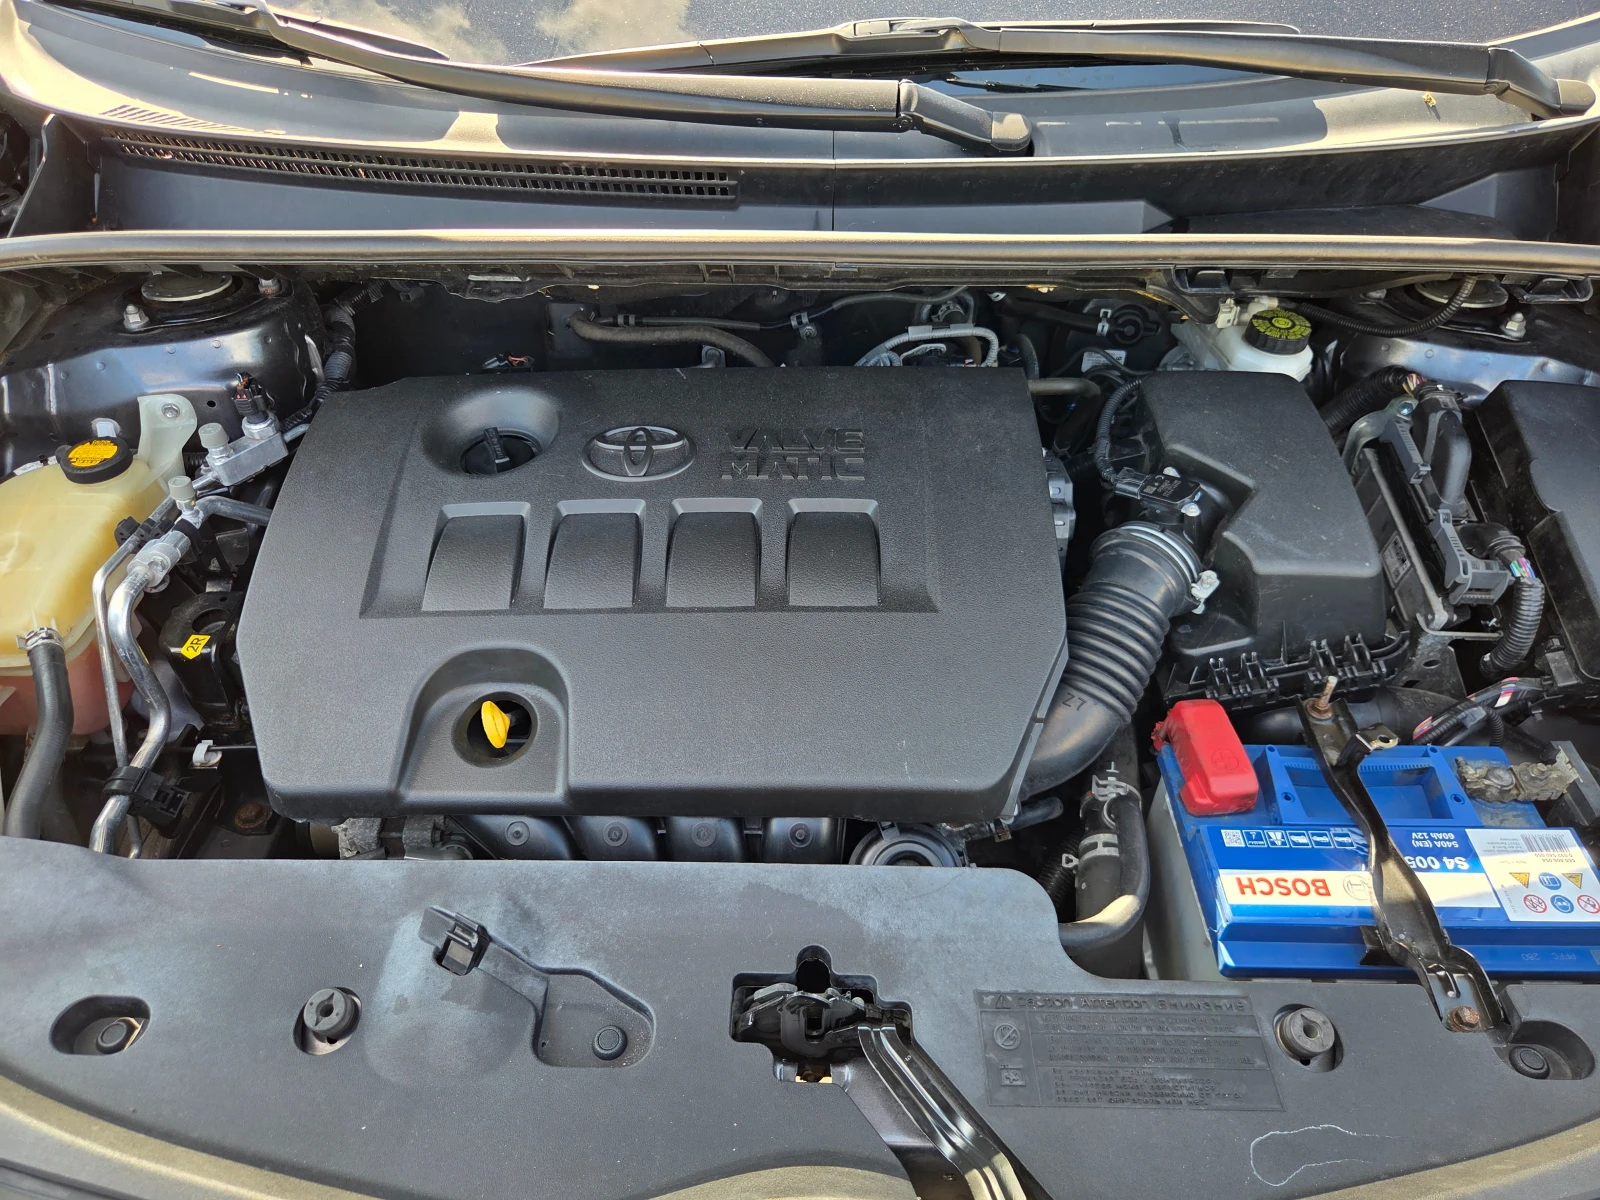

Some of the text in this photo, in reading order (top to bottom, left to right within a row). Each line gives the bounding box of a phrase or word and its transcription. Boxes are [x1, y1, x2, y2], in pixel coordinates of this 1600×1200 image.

[724, 428, 865, 453] VALVE
[721, 452, 866, 481] MATIC
[187, 638, 206, 653] 2R
[1411, 839, 1459, 848] 540A (EN)
[1430, 832, 1455, 840] 60Ah
[1404, 855, 1470, 870] S4 005
[1235, 876, 1332, 897] BOSCH
[1018, 997, 1246, 1012] Caution Attention Внимание
